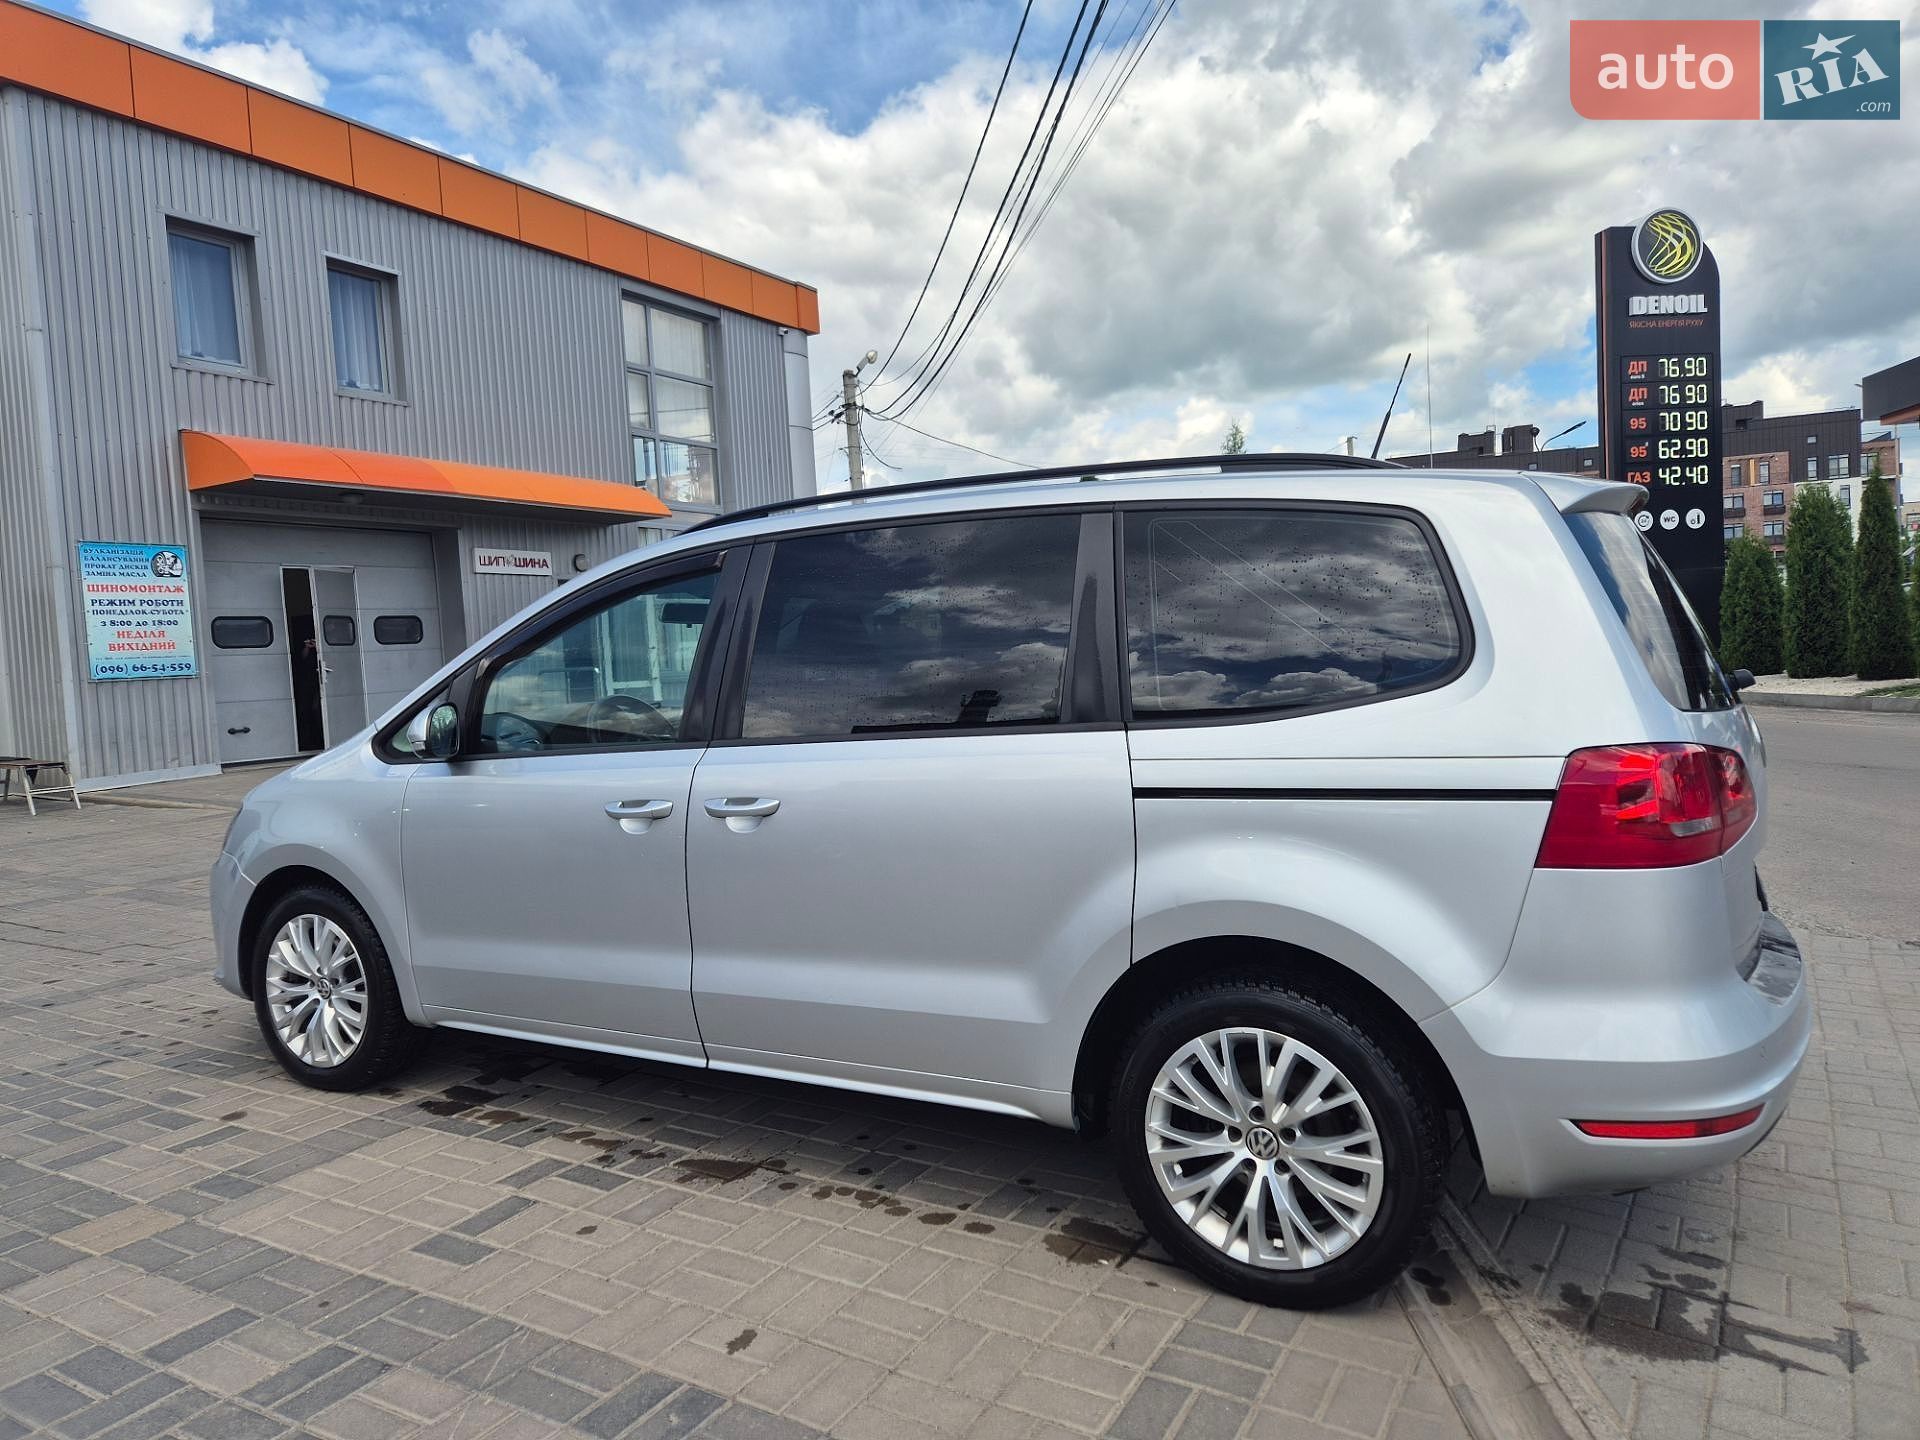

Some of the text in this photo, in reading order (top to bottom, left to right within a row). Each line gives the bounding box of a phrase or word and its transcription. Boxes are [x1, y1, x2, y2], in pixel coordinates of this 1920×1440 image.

[1629, 294, 1708, 316] DENOIL
[1628, 360, 1648, 375] ДП
[1628, 387, 1648, 402] ДП
[1630, 417, 1647, 430] 95
[1658, 438, 1709, 459] 62.90
[1627, 465, 1709, 486] ГАЗ 42.40
[514, 557, 550, 569] ШИНА
[87, 584, 185, 593] ШИНОМОНТАЖ
[91, 599, 185, 607] РЕЖИМ РОБОТИ
[116, 630, 166, 640] НЕДІЛЯ
[108, 640, 177, 652] ВИХІДНИЙ
[95, 662, 192, 676] (096) 66-54-559
